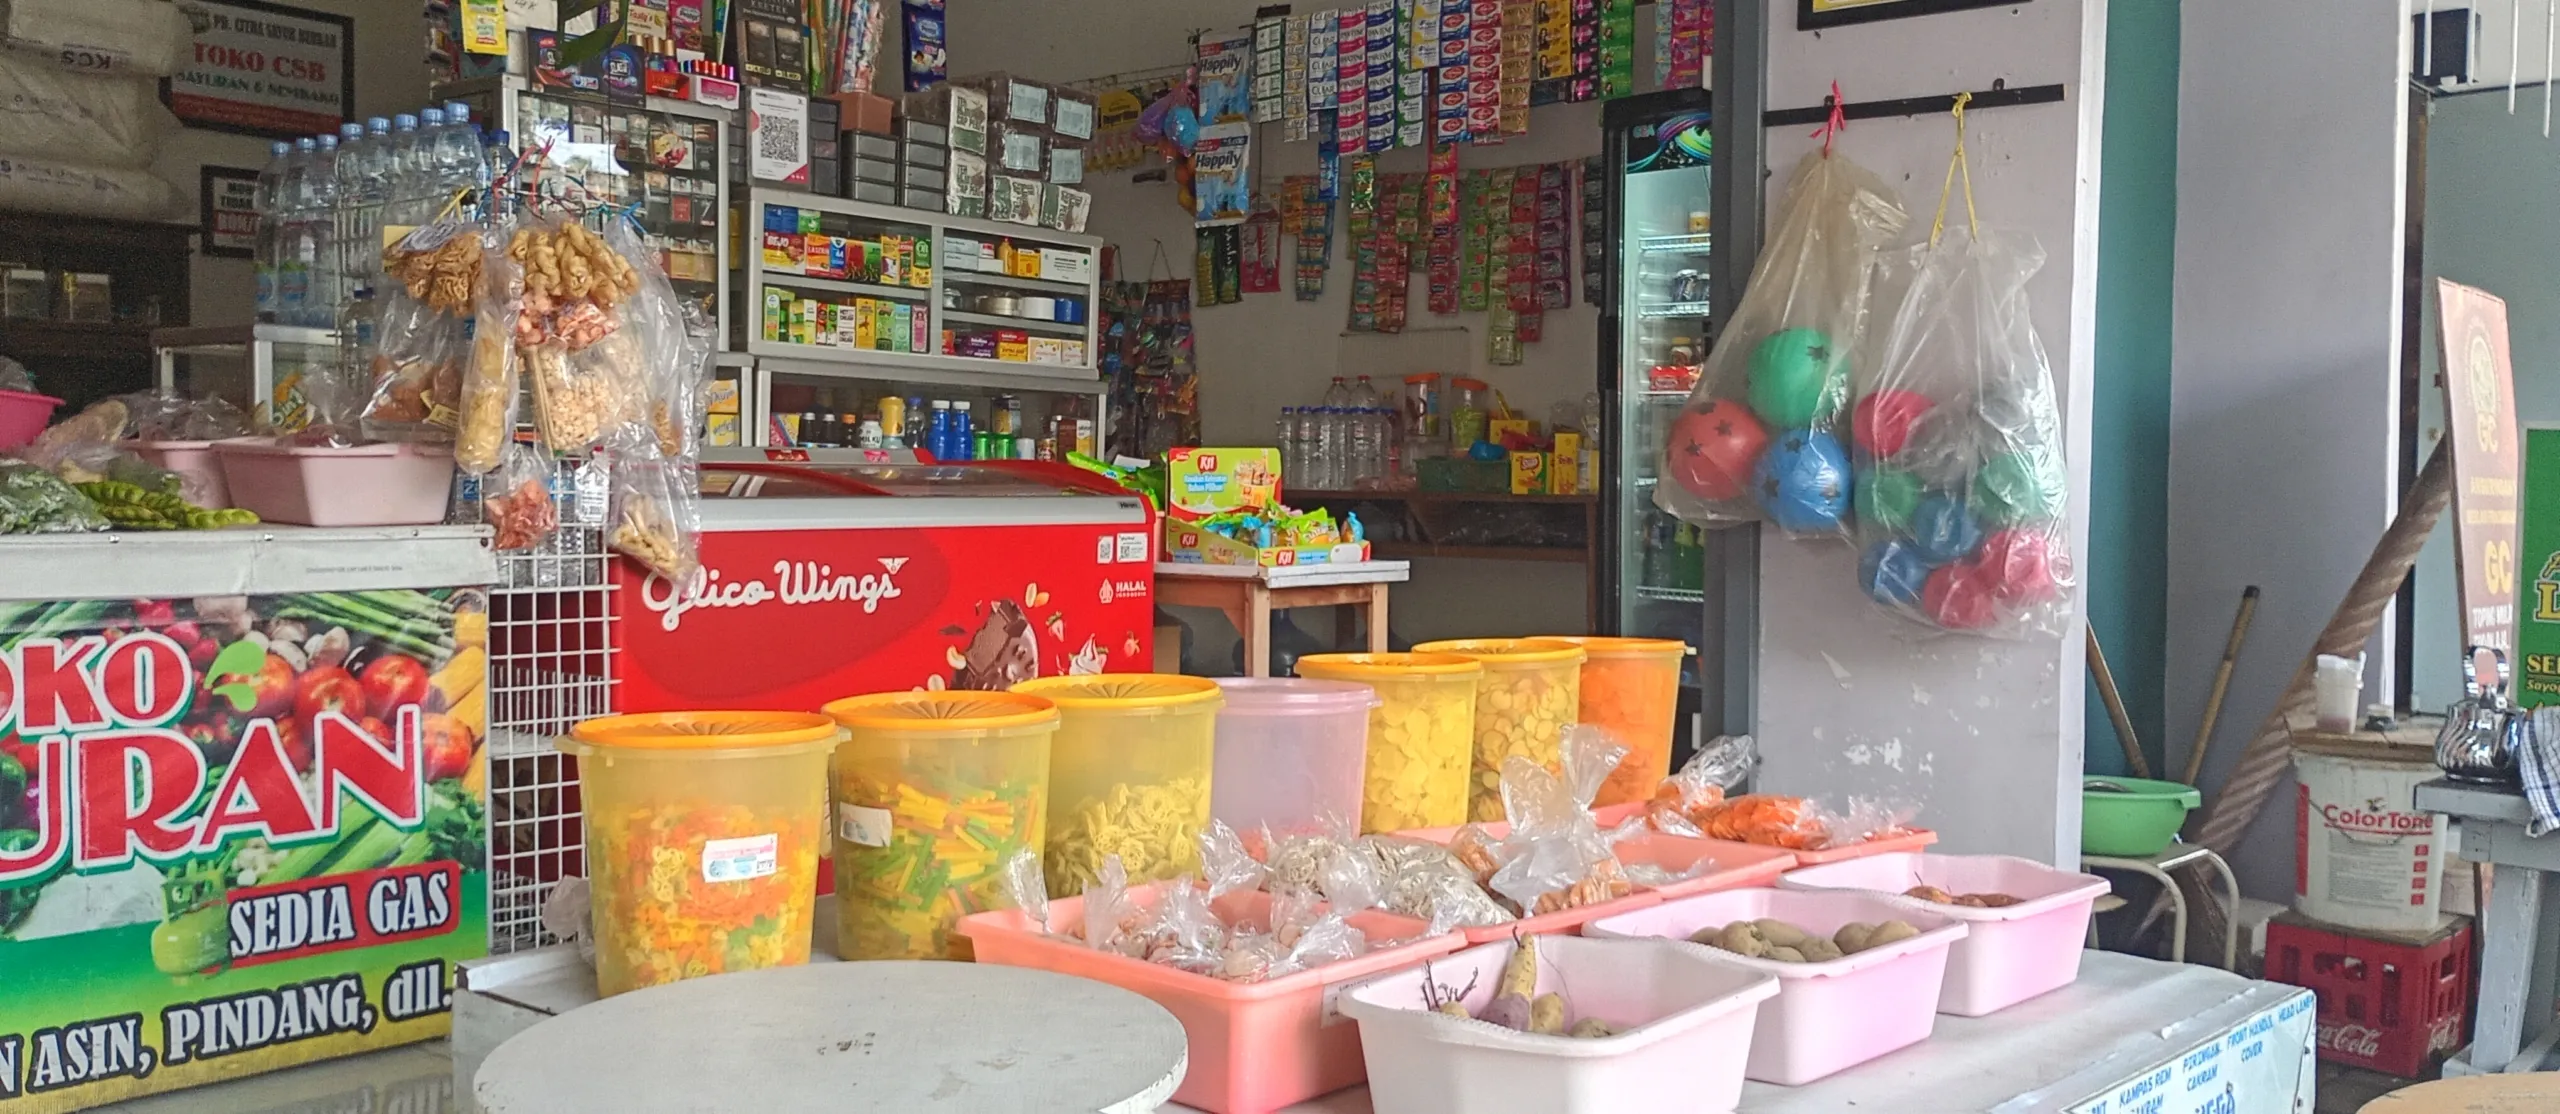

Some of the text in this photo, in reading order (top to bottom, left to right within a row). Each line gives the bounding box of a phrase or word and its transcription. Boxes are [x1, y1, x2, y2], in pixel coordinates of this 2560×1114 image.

[192, 42, 327, 84] TOKO CSB
[1200, 56, 1242, 73] Happily
[1196, 151, 1242, 169] Happily
[767, 235, 789, 247] BEJO
[774, 560, 902, 614] Wings
[1115, 580, 1147, 592] HALAL
[2484, 540, 2512, 595] GC
[229, 871, 450, 959] SEDIA GAS
[33, 1017, 153, 1088] ASIN,
[167, 978, 375, 1062] PINDANG,
[387, 963, 454, 1019] dll.
